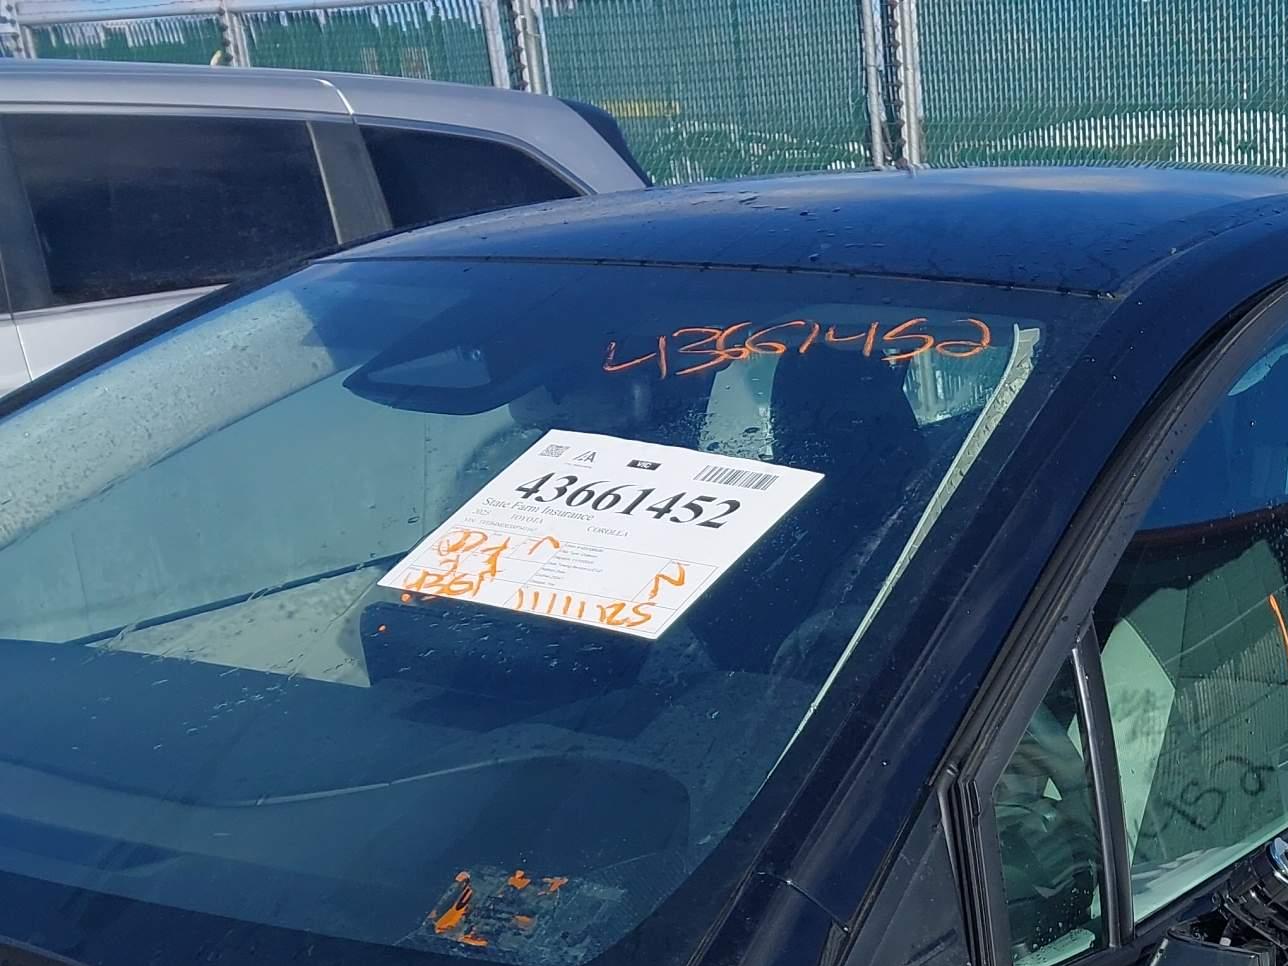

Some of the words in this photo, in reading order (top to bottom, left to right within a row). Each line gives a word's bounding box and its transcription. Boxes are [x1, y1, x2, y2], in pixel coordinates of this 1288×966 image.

[482, 497, 511, 509] State
[512, 502, 540, 513] Farm
[541, 505, 595, 521] Insurance
[515, 472, 741, 530] 43661452
